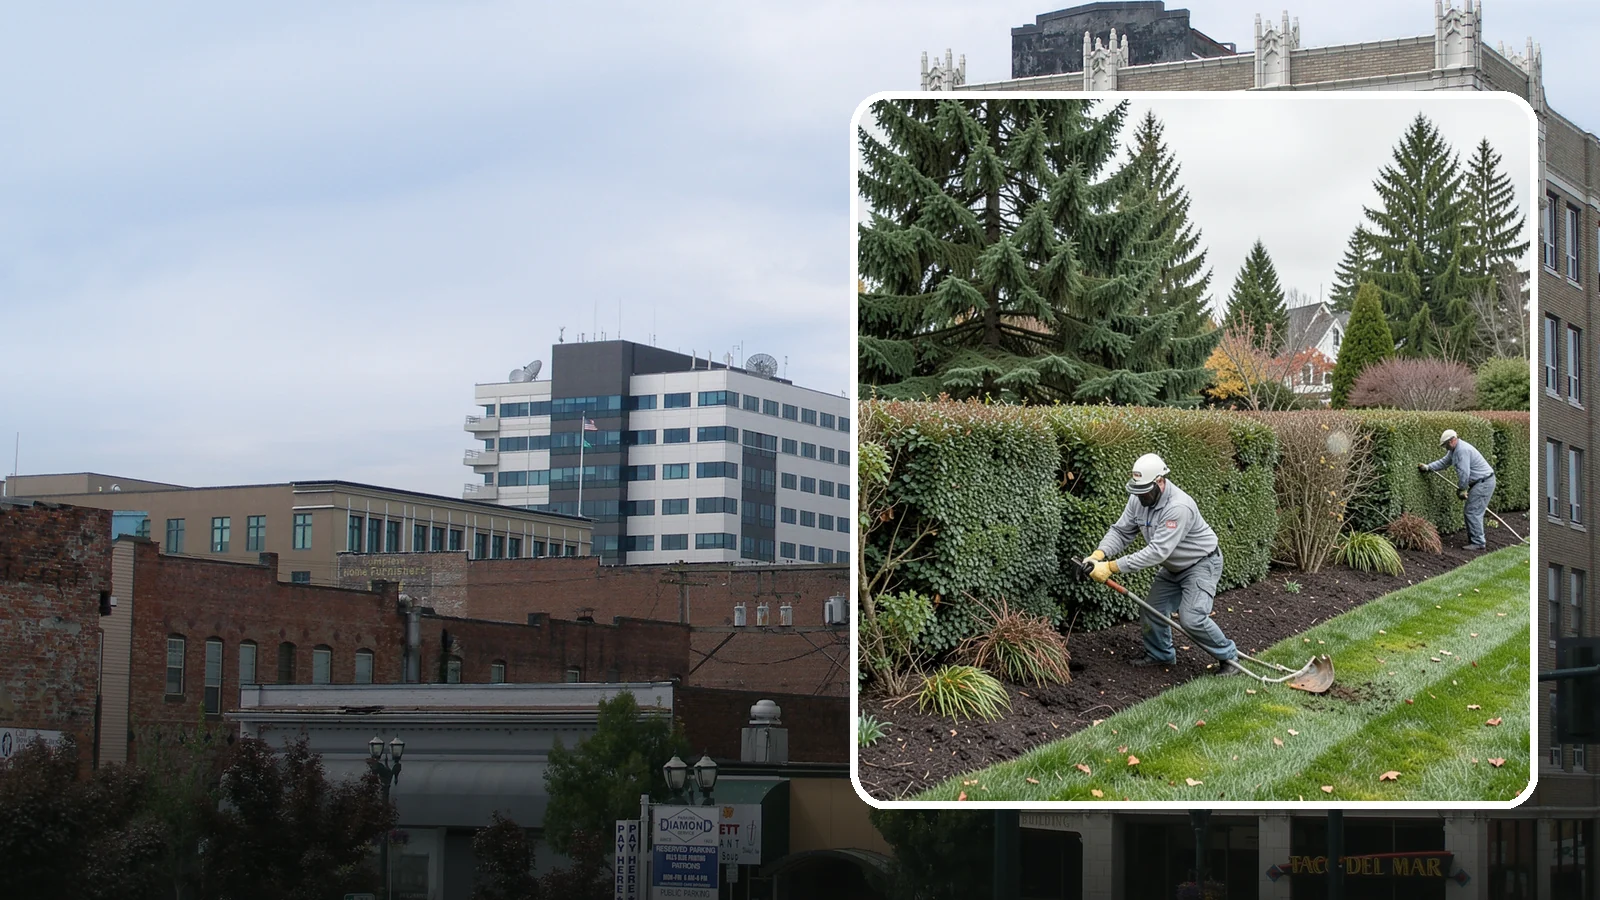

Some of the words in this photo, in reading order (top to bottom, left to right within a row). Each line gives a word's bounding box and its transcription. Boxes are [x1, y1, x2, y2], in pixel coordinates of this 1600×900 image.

[362, 556, 406, 567] Complete
[343, 568, 368, 577] Home
[371, 566, 427, 577] Furnishers
[660, 818, 713, 833] DIAMOND
[1022, 815, 1070, 828] BUILDING
[617, 825, 625, 852] PAY
[628, 825, 637, 852] PAY
[656, 845, 688, 853] RESERVED
[689, 846, 716, 854] PARKING
[721, 851, 739, 863] Soup
[671, 862, 701, 870] PATRONS
[1345, 856, 1385, 876] DEL
[1392, 857, 1442, 877] MAR
[616, 856, 625, 893] HERE
[627, 856, 636, 893] HERE
[660, 889, 681, 897] PUBLIC
[683, 889, 710, 898] PARKING
